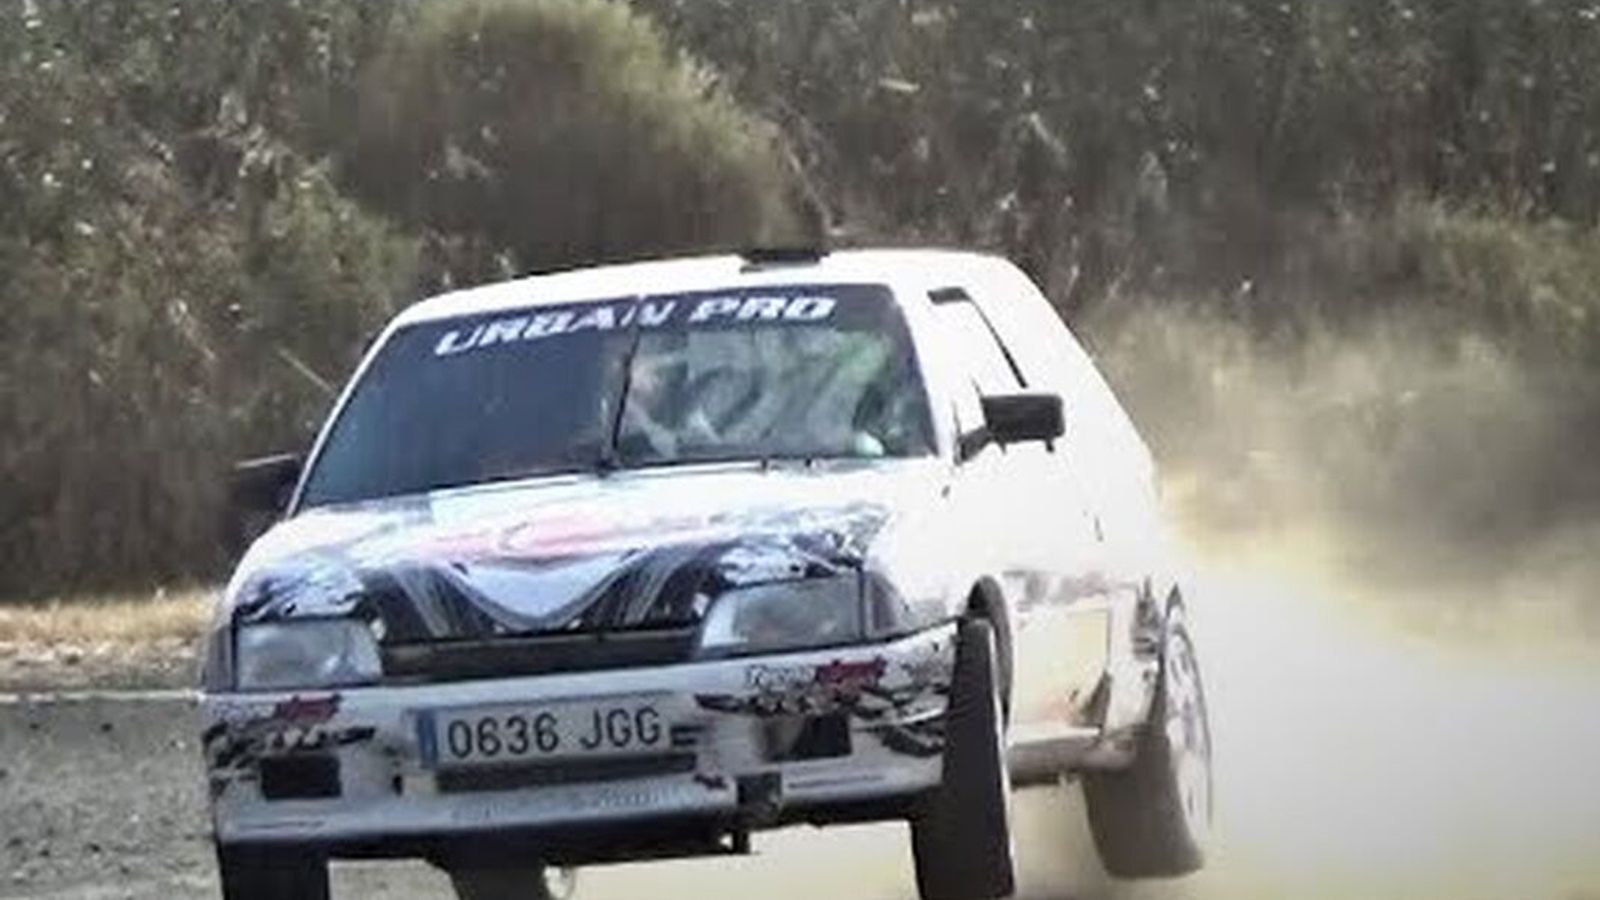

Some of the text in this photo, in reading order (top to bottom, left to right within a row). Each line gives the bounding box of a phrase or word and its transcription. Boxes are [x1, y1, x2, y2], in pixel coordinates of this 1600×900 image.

[435, 297, 837, 355] URBAN PRO
[448, 706, 660, 758] 0636 JGG
